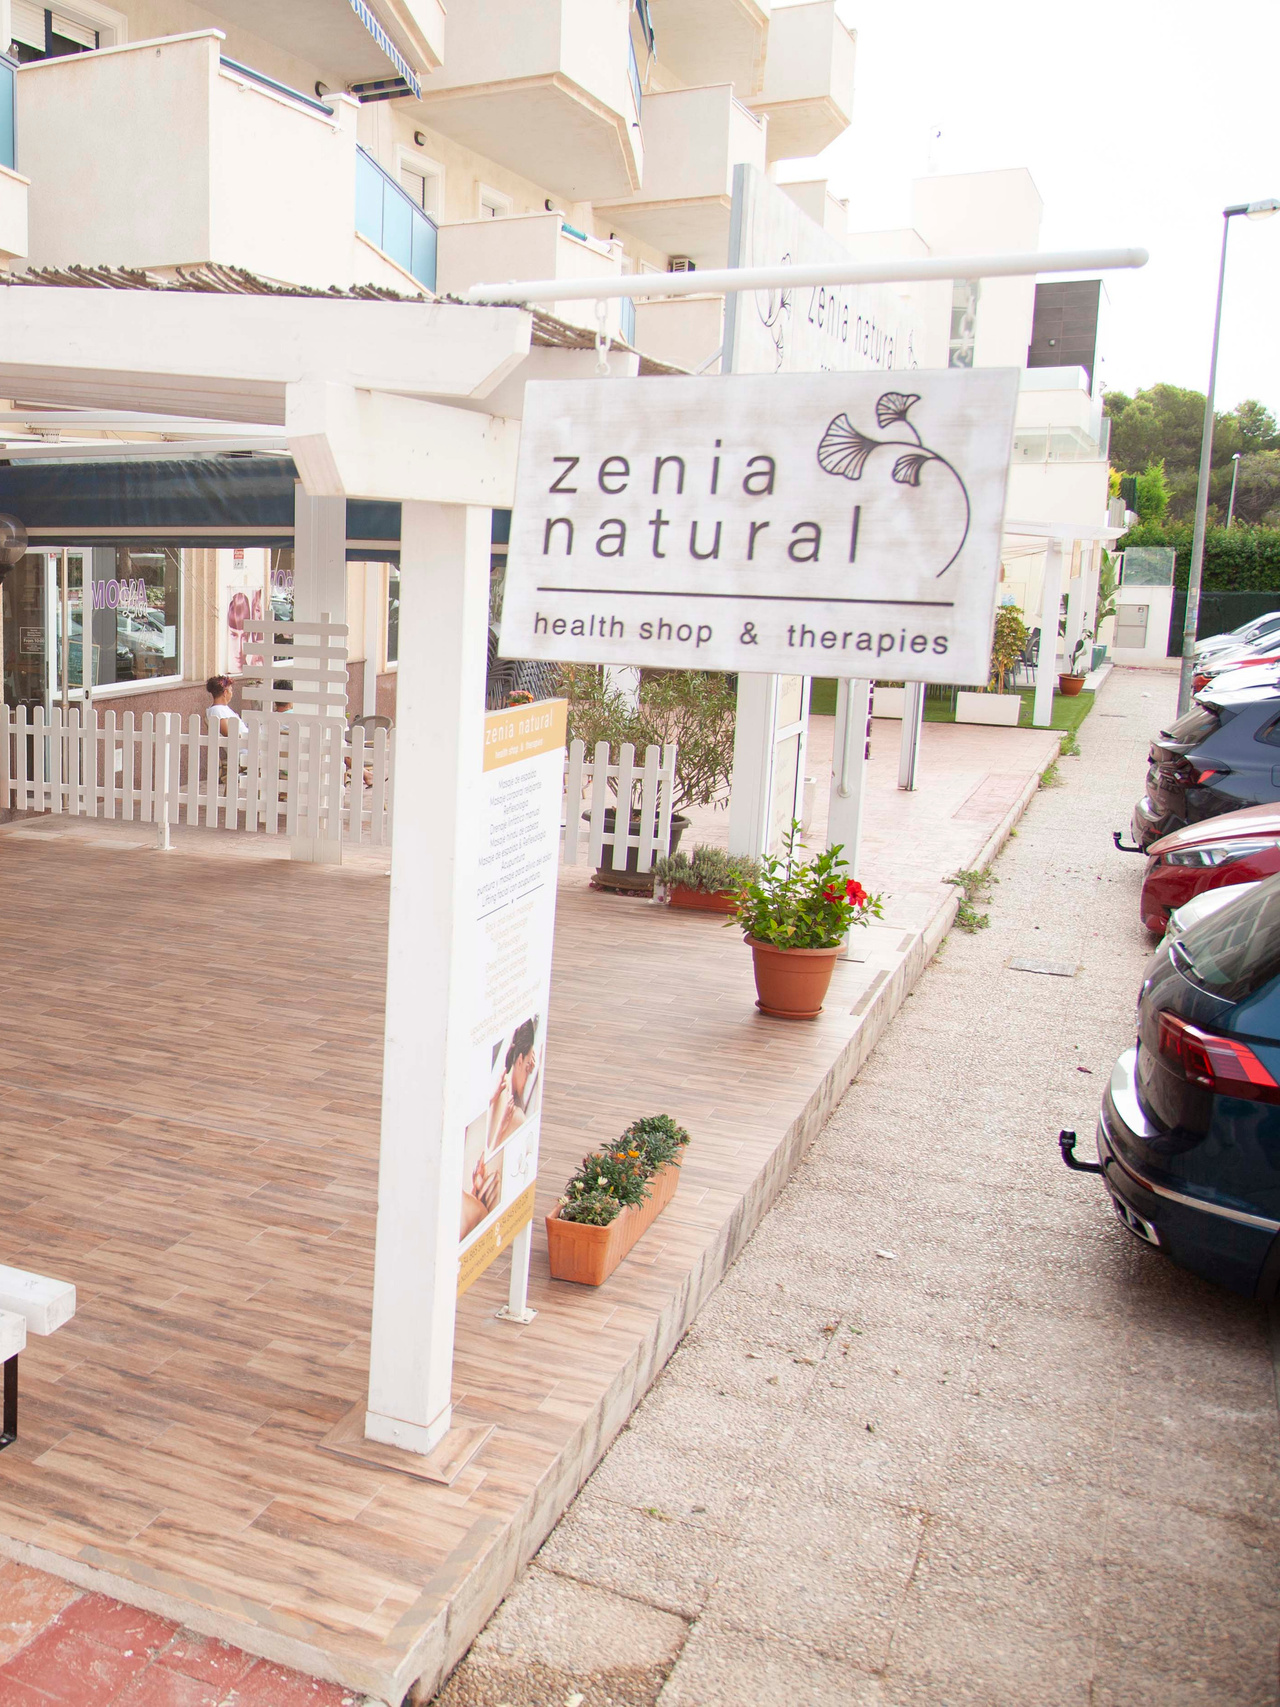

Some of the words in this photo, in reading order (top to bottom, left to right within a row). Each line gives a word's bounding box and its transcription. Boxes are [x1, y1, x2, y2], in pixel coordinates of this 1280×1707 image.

[855, 315, 898, 370] natural
[549, 439, 776, 496] zenia
[543, 505, 861, 564] natural
[91, 578, 148, 610] MONA
[533, 612, 624, 638] health
[639, 617, 713, 648] shop
[740, 622, 759, 645] &
[787, 624, 949, 657] therapies
[486, 720, 514, 745] zenia
[518, 708, 553, 735] natural
[477, 881, 495, 897] puntura
